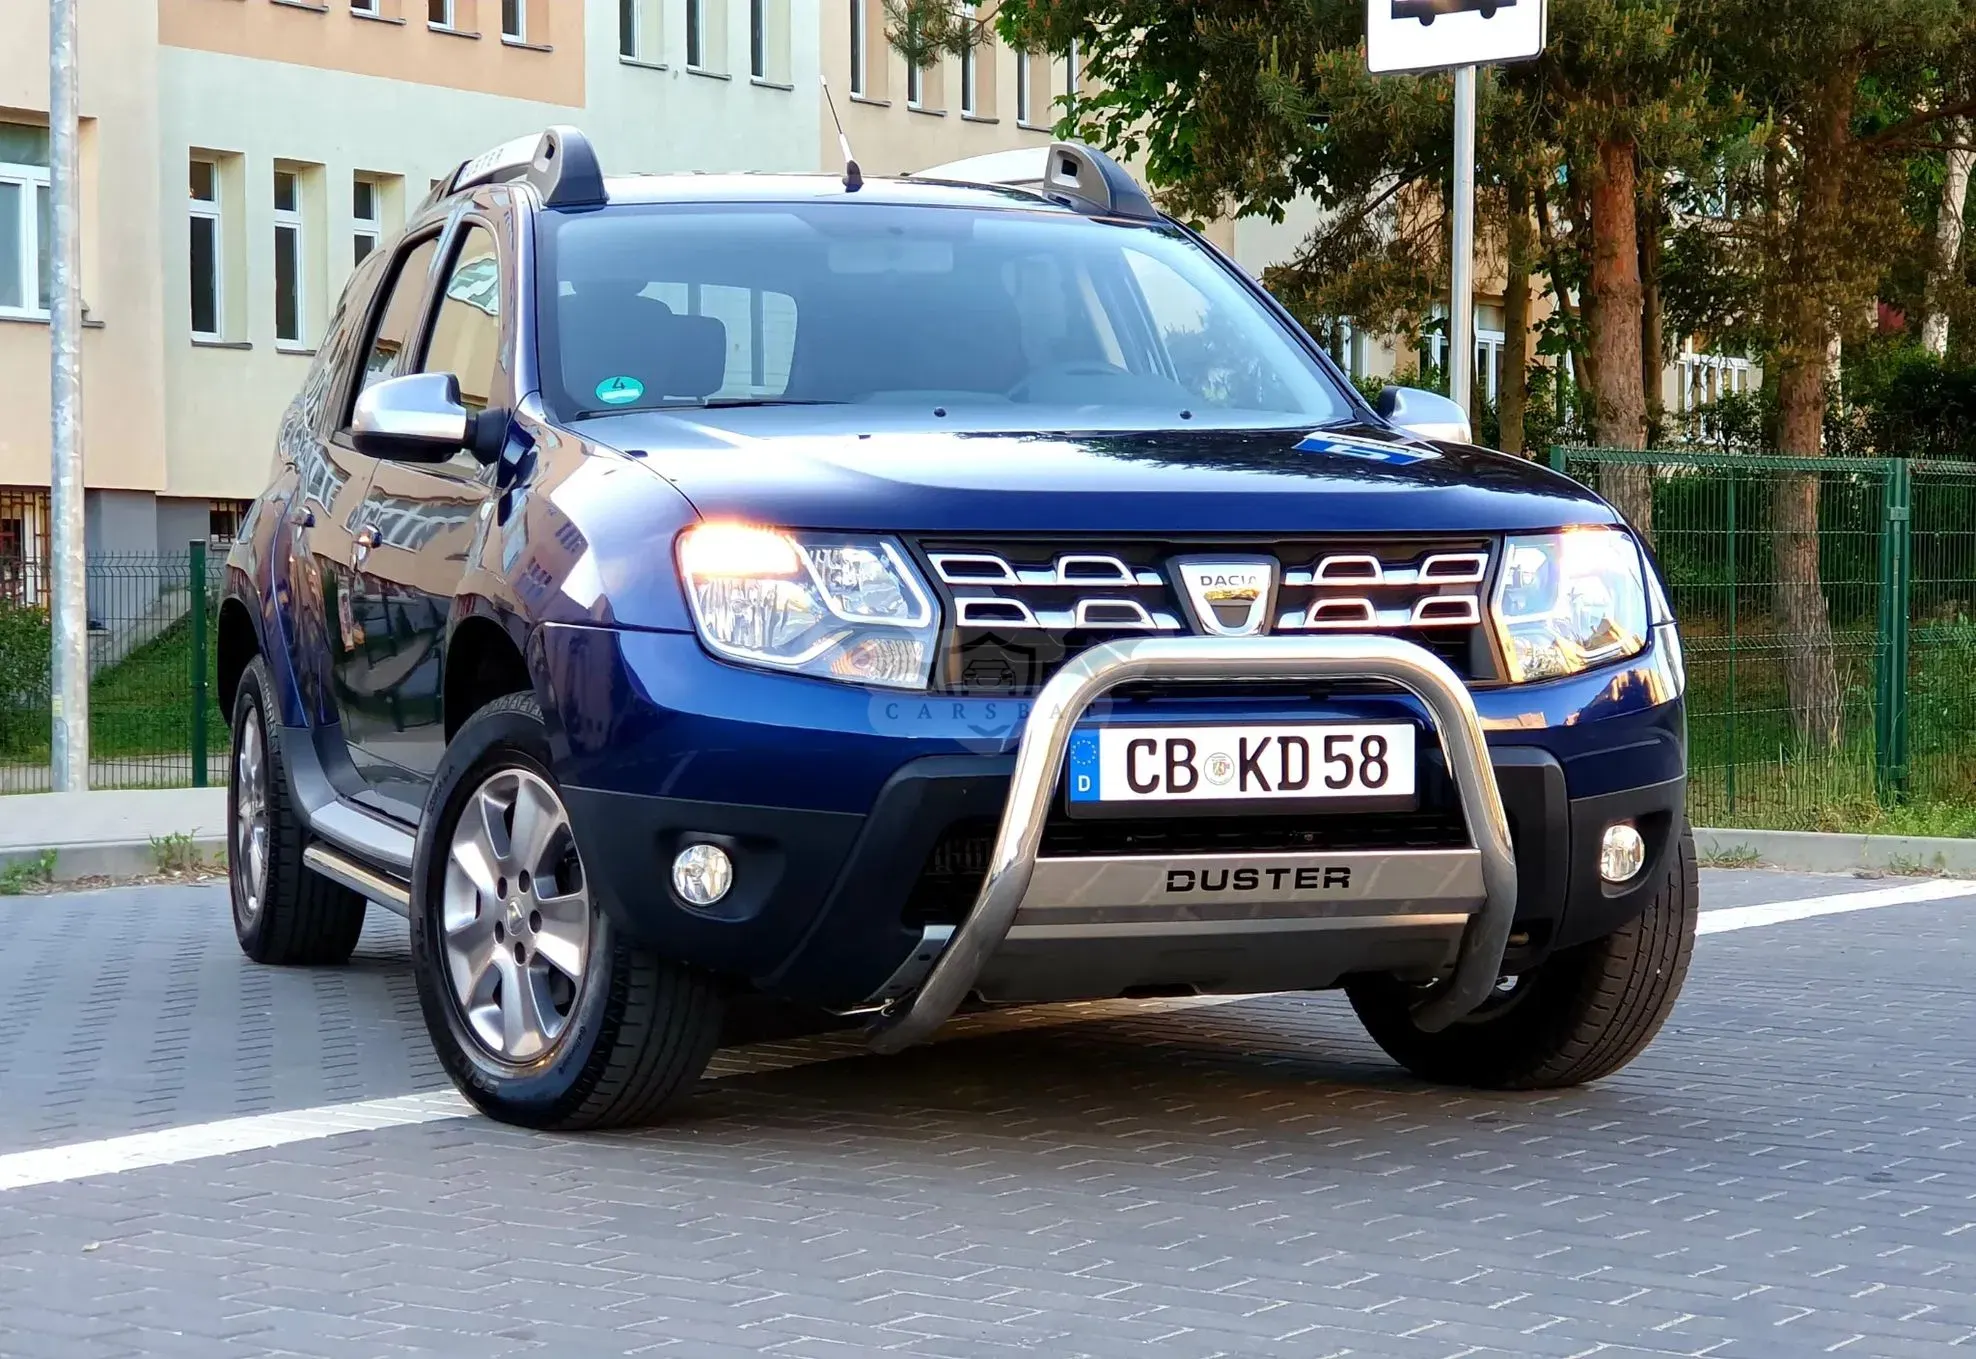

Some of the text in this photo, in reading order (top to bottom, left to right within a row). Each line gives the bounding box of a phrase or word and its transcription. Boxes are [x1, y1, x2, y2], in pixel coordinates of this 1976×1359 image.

[1200, 575, 1257, 586] DACIA
[1126, 737, 1200, 794] CB
[1077, 775, 1091, 792] D
[1165, 866, 1352, 892] DUSTER
